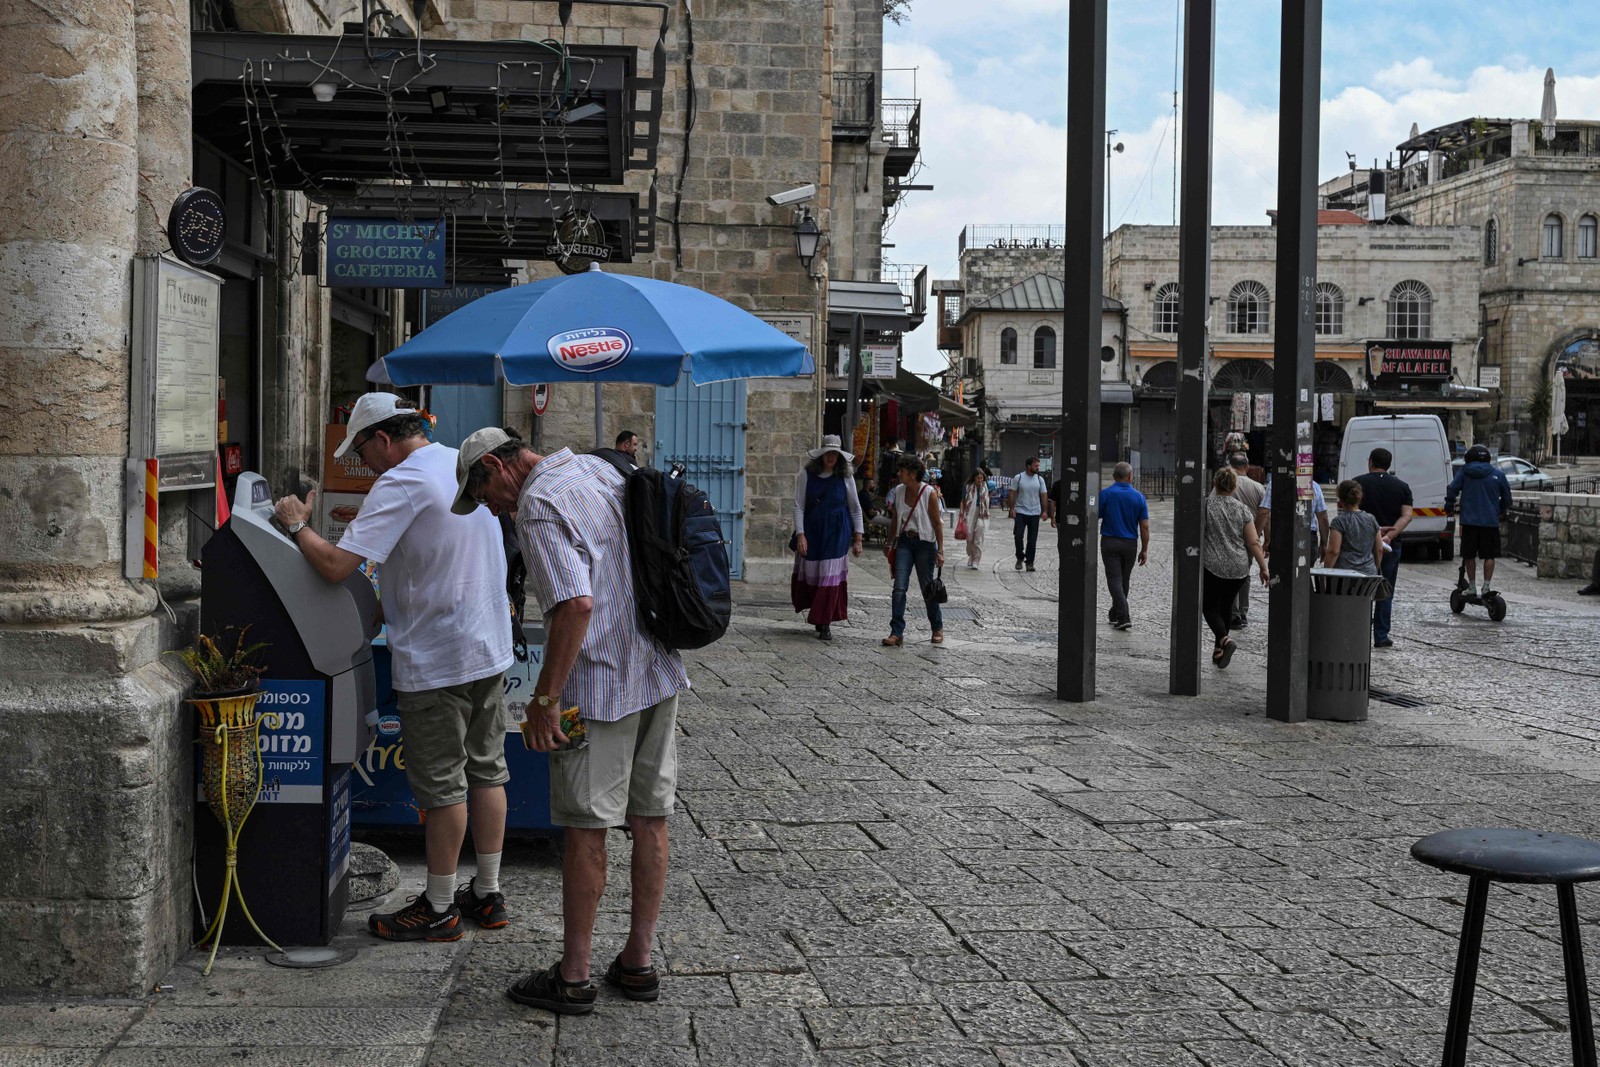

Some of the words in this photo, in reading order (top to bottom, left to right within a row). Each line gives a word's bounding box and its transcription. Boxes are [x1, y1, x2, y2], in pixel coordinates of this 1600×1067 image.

[356, 224, 439, 240] MICHEL
[336, 245, 423, 260] GROCERY
[427, 250, 436, 260] &
[334, 264, 438, 278] CAFETERIA
[565, 328, 607, 341] גלידות
[1385, 348, 1451, 360] SHAWARMA
[344, 466, 380, 478] SANDW
[429, 914, 454, 929] SCARPA
